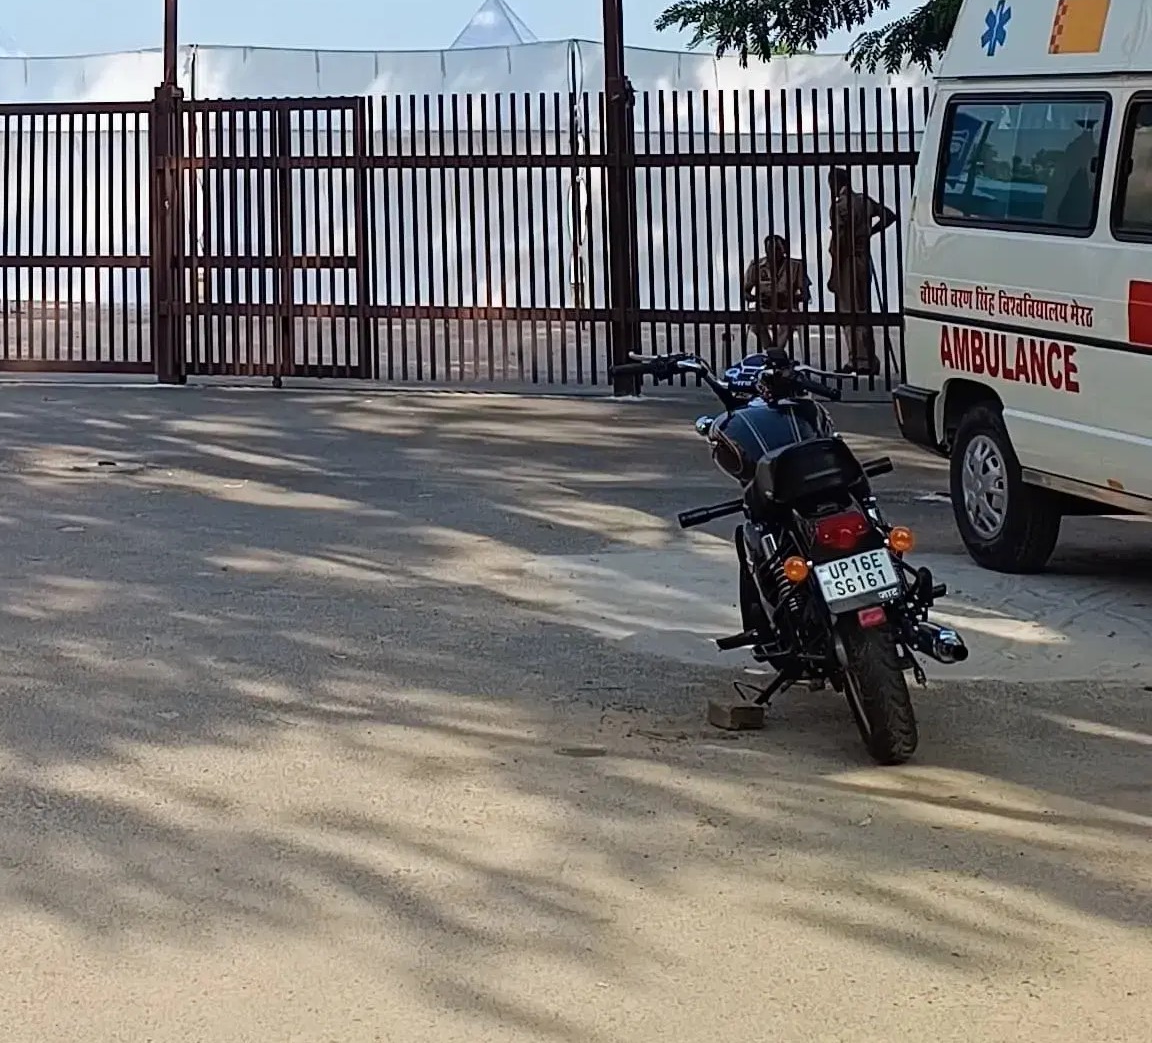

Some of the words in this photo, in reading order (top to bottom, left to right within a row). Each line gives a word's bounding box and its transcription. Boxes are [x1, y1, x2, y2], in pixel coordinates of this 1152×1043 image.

[1070, 298, 1094, 328] मेरठ
[940, 324, 1080, 393] AMBULANCE
[829, 552, 883, 579] UP16E
[834, 569, 887, 596] S6161
